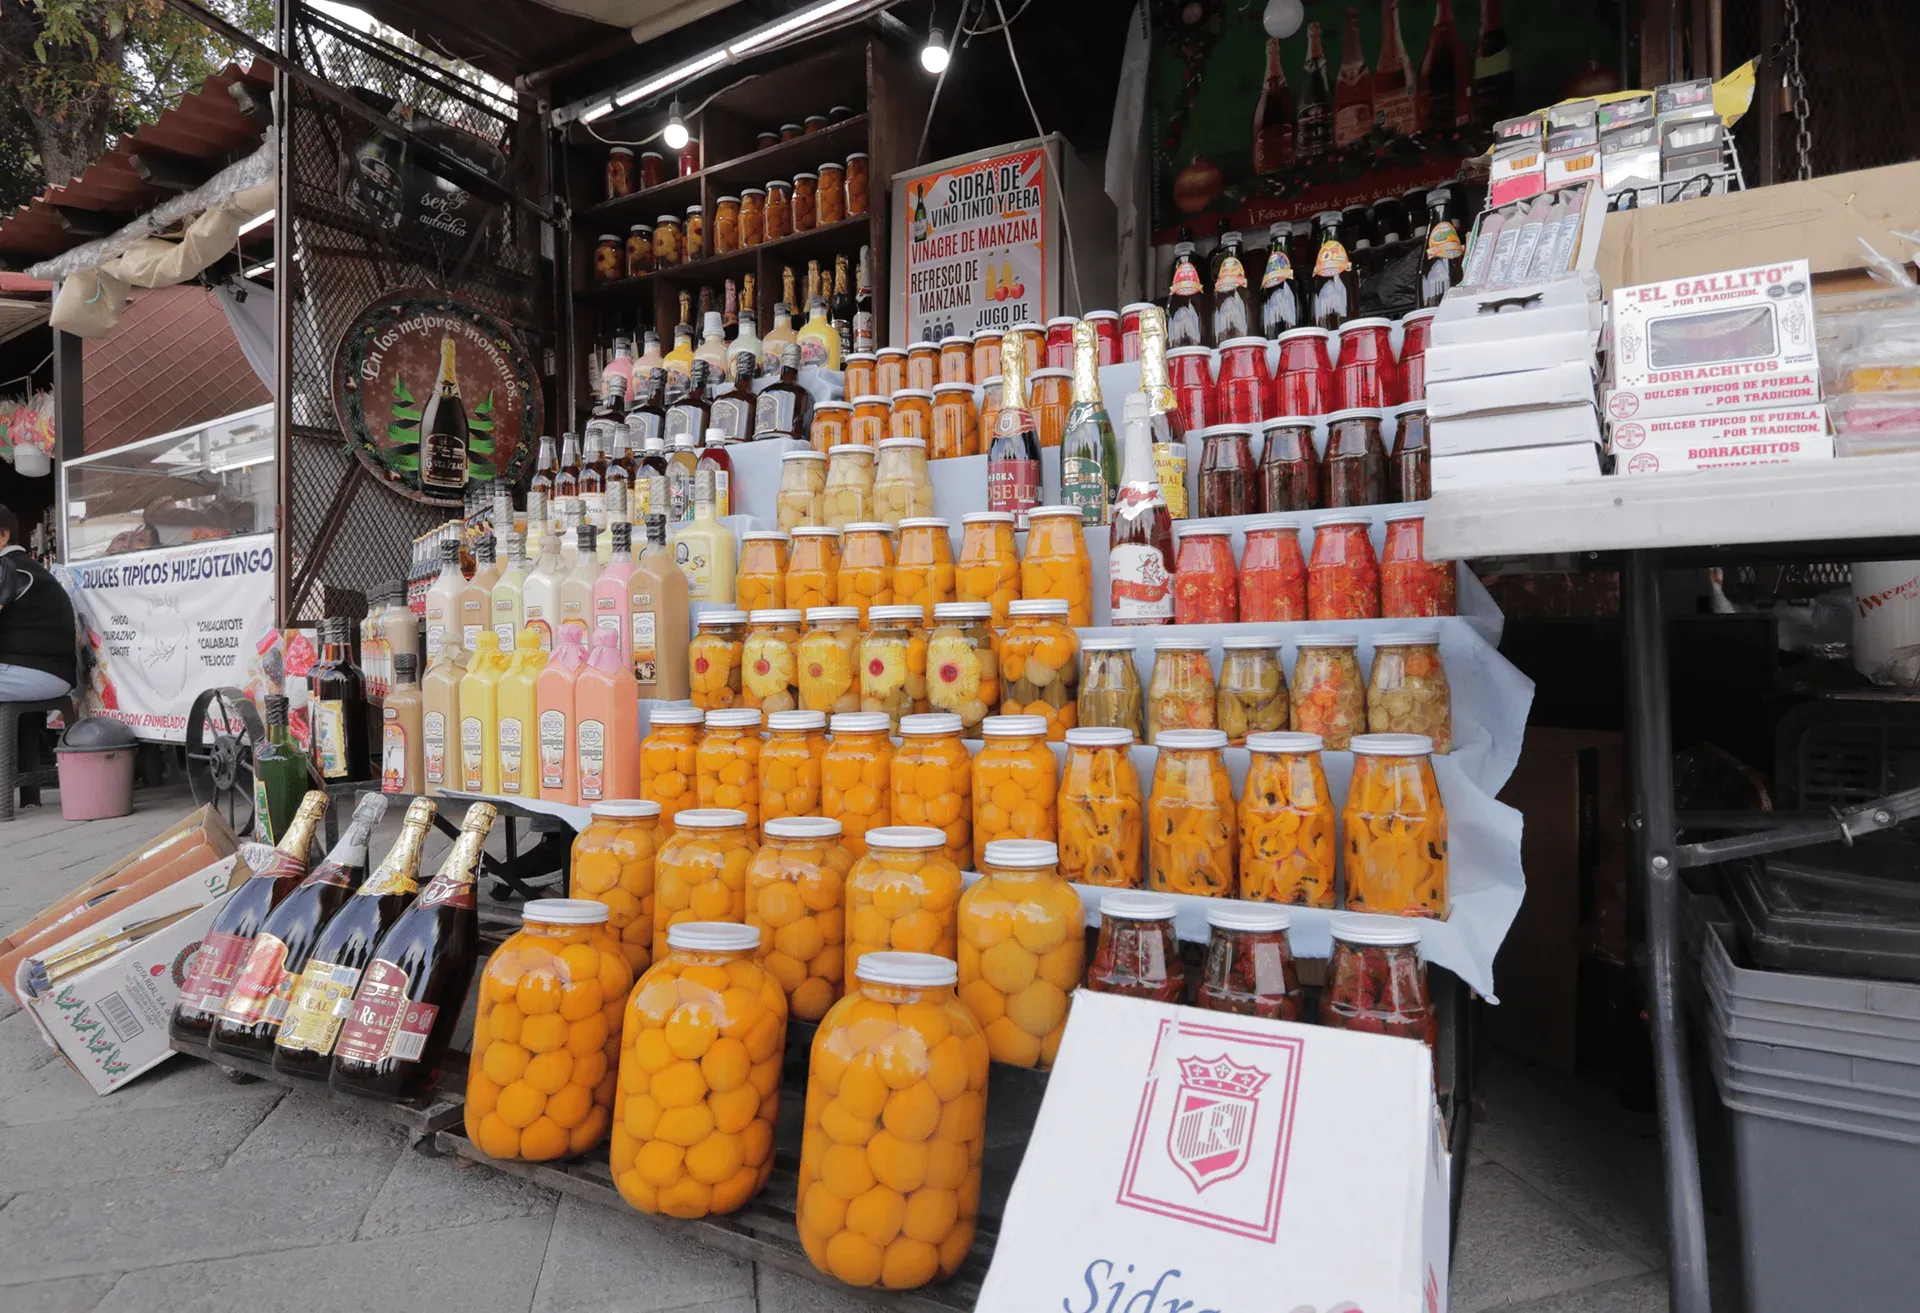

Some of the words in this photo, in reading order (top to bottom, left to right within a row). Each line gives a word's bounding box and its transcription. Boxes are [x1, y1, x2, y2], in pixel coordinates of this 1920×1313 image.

[949, 170, 995, 204] SIDRA
[1001, 164, 1021, 192] DE
[421, 192, 448, 213] ser
[931, 205, 959, 229] VINO
[961, 197, 994, 223] TINTO
[997, 194, 1006, 213] Y
[1008, 187, 1040, 212] PERA
[911, 233, 958, 264] VINAGRE
[961, 229, 975, 253] DE
[978, 218, 1038, 249] MANZANA
[911, 262, 961, 294] REFRESCO
[964, 259, 978, 282] DE
[919, 284, 971, 315] MANZANA
[1672, 296, 1694, 307] POR
[976, 307, 1009, 327] JUGO
[1013, 303, 1028, 321] DE
[361, 353, 383, 381] En
[373, 329, 399, 352] los
[399, 312, 461, 336] mejores
[1647, 360, 1779, 384] BORRACHITOS
[1644, 386, 1689, 400] DULCES
[1692, 382, 1740, 396] TIPICOS
[1743, 381, 1757, 393] DE
[1716, 394, 1740, 406] POR
[1651, 419, 1696, 432] DULCES
[1699, 415, 1746, 428] TIPICOS
[1750, 413, 1765, 425] DE
[1723, 427, 1747, 438] POR
[1688, 442, 1800, 460] BORRACHITOS
[82, 567, 119, 589] DULCES
[122, 557, 168, 588] TIPÍCOS
[171, 547, 273, 583] HUEJOTZINGO
[124, 713, 143, 727] CON
[142, 714, 187, 730] ENMIELADO
[132, 961, 148, 980] GOTA
